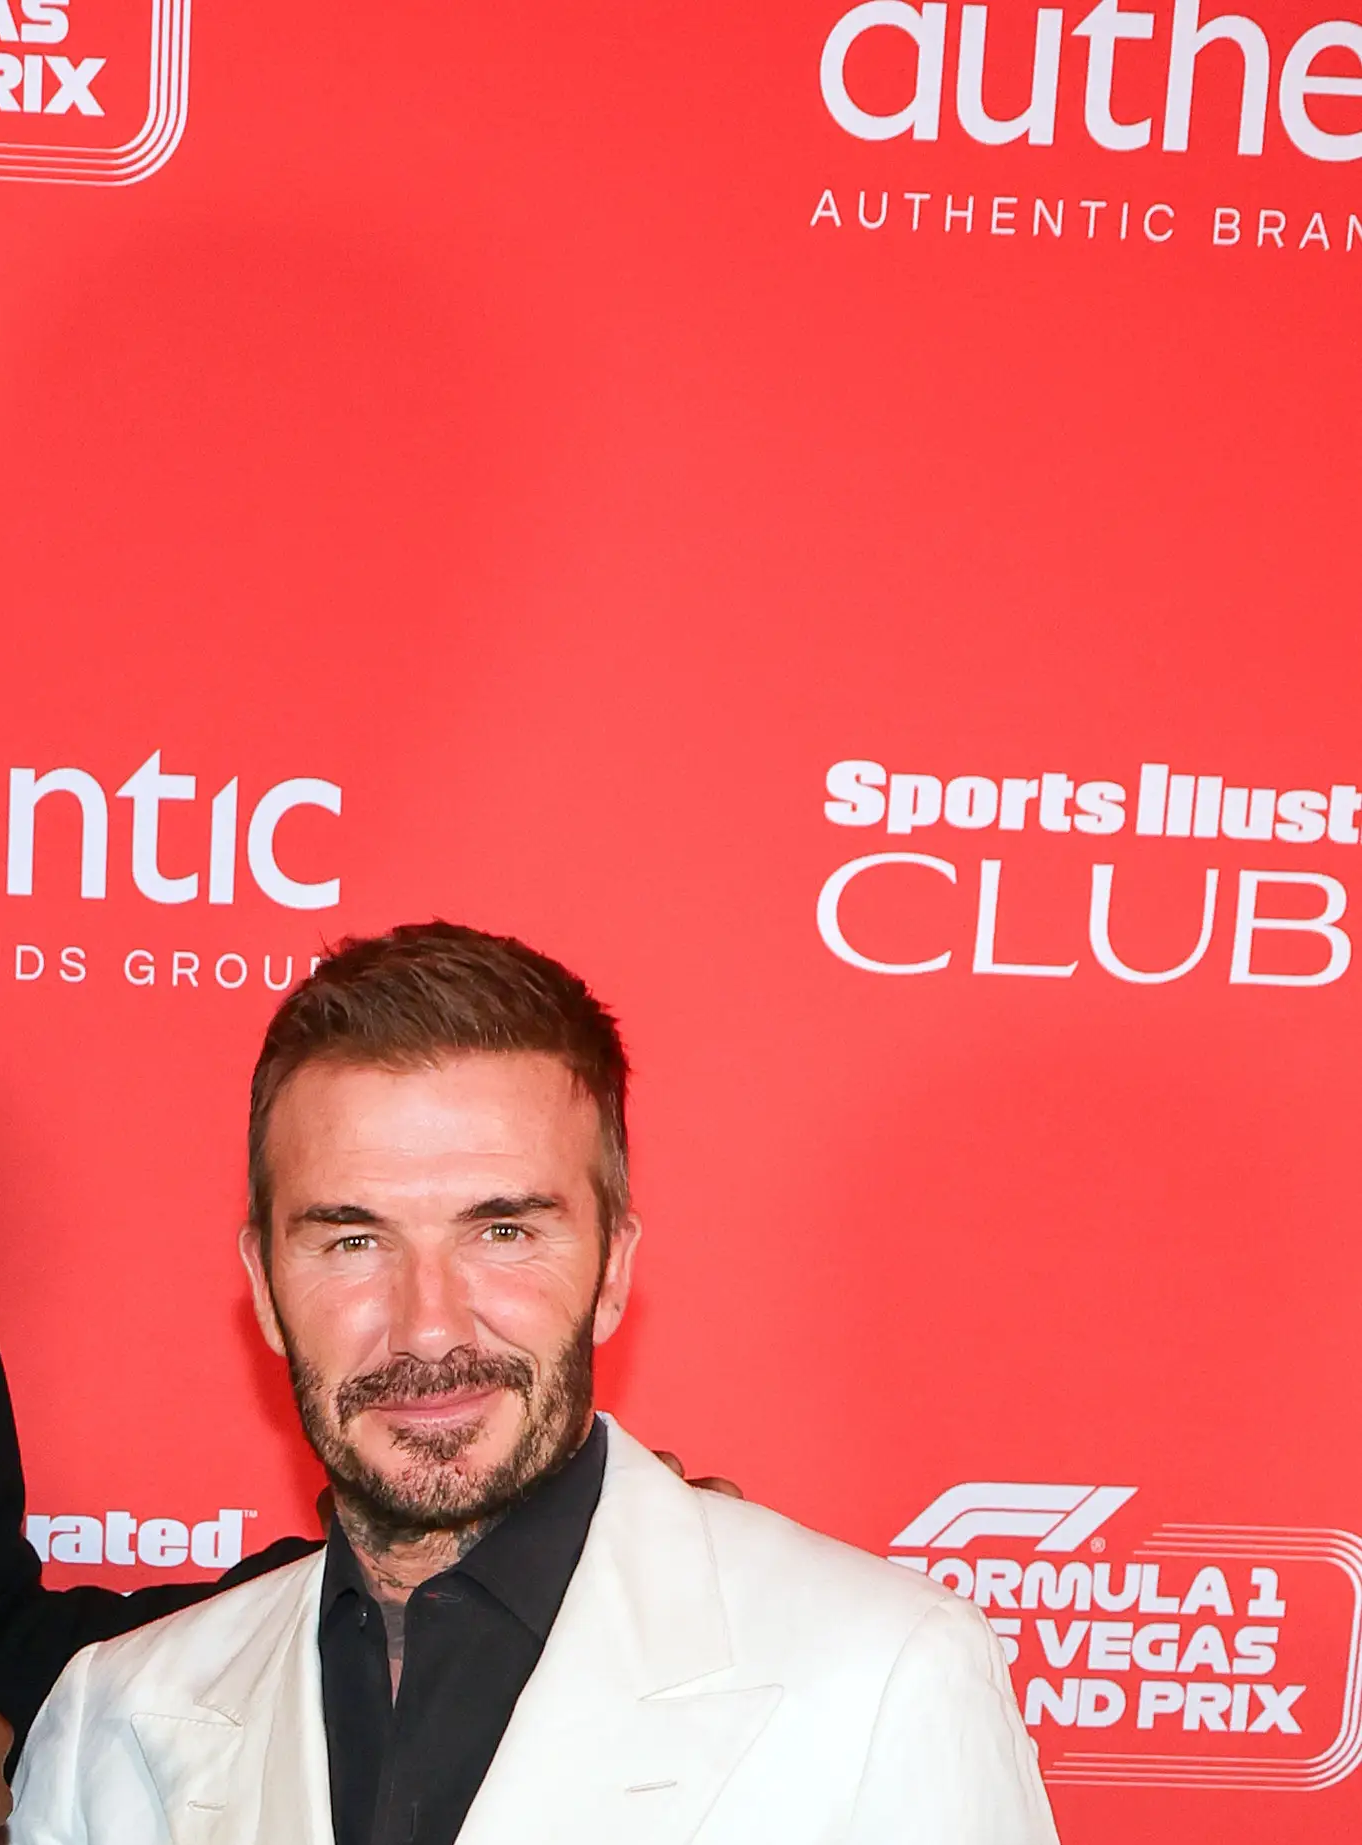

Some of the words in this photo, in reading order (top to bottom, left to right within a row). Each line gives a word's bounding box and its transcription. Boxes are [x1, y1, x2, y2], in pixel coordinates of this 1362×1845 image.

[809, 188, 1176, 242] AUTHENTIC
[824, 759, 1126, 834] Sports
[815, 850, 1354, 988] CLUB
[124, 950, 323, 991] GROU
[1247, 1568, 1286, 1617] 1
[1034, 1618, 1279, 1676] VEGAS
[1137, 1681, 1306, 1735] PRIX
